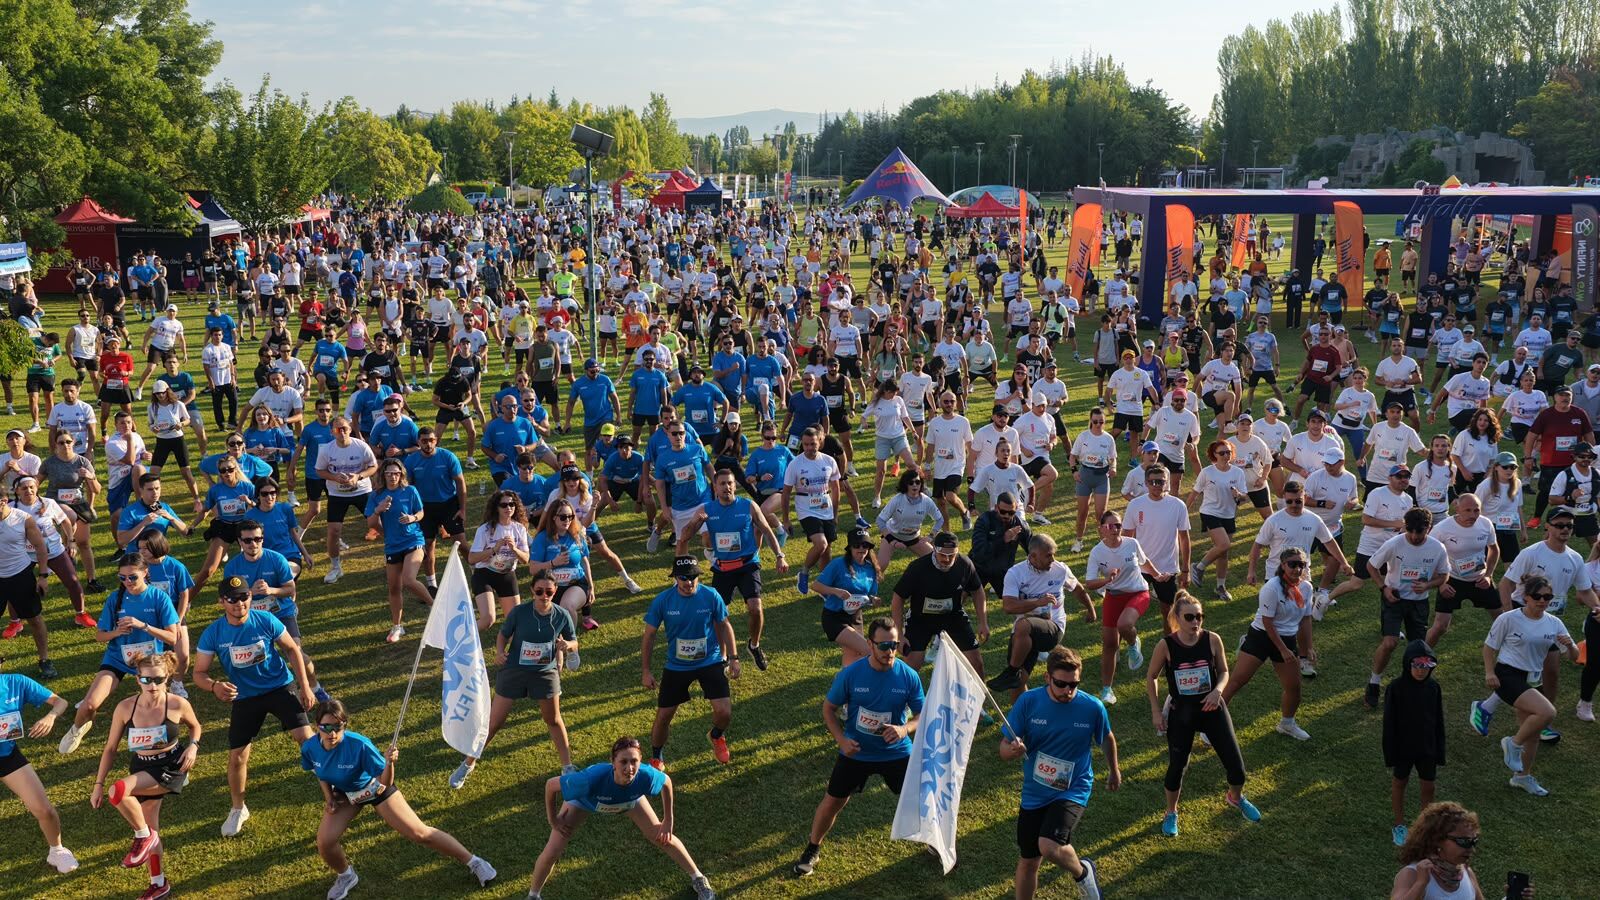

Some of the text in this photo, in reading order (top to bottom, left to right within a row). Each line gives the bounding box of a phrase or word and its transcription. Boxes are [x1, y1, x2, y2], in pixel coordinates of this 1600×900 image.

[876, 178, 900, 190] Red
[676, 557, 698, 567] CLOUD
[233, 651, 253, 661] 1719
[523, 649, 541, 657] 1323
[1179, 676, 1199, 685] 1343
[859, 714, 879, 726] 1773
[1031, 718, 1047, 726] HOKA
[131, 735, 152, 744] 1712
[1038, 763, 1057, 775] 639
